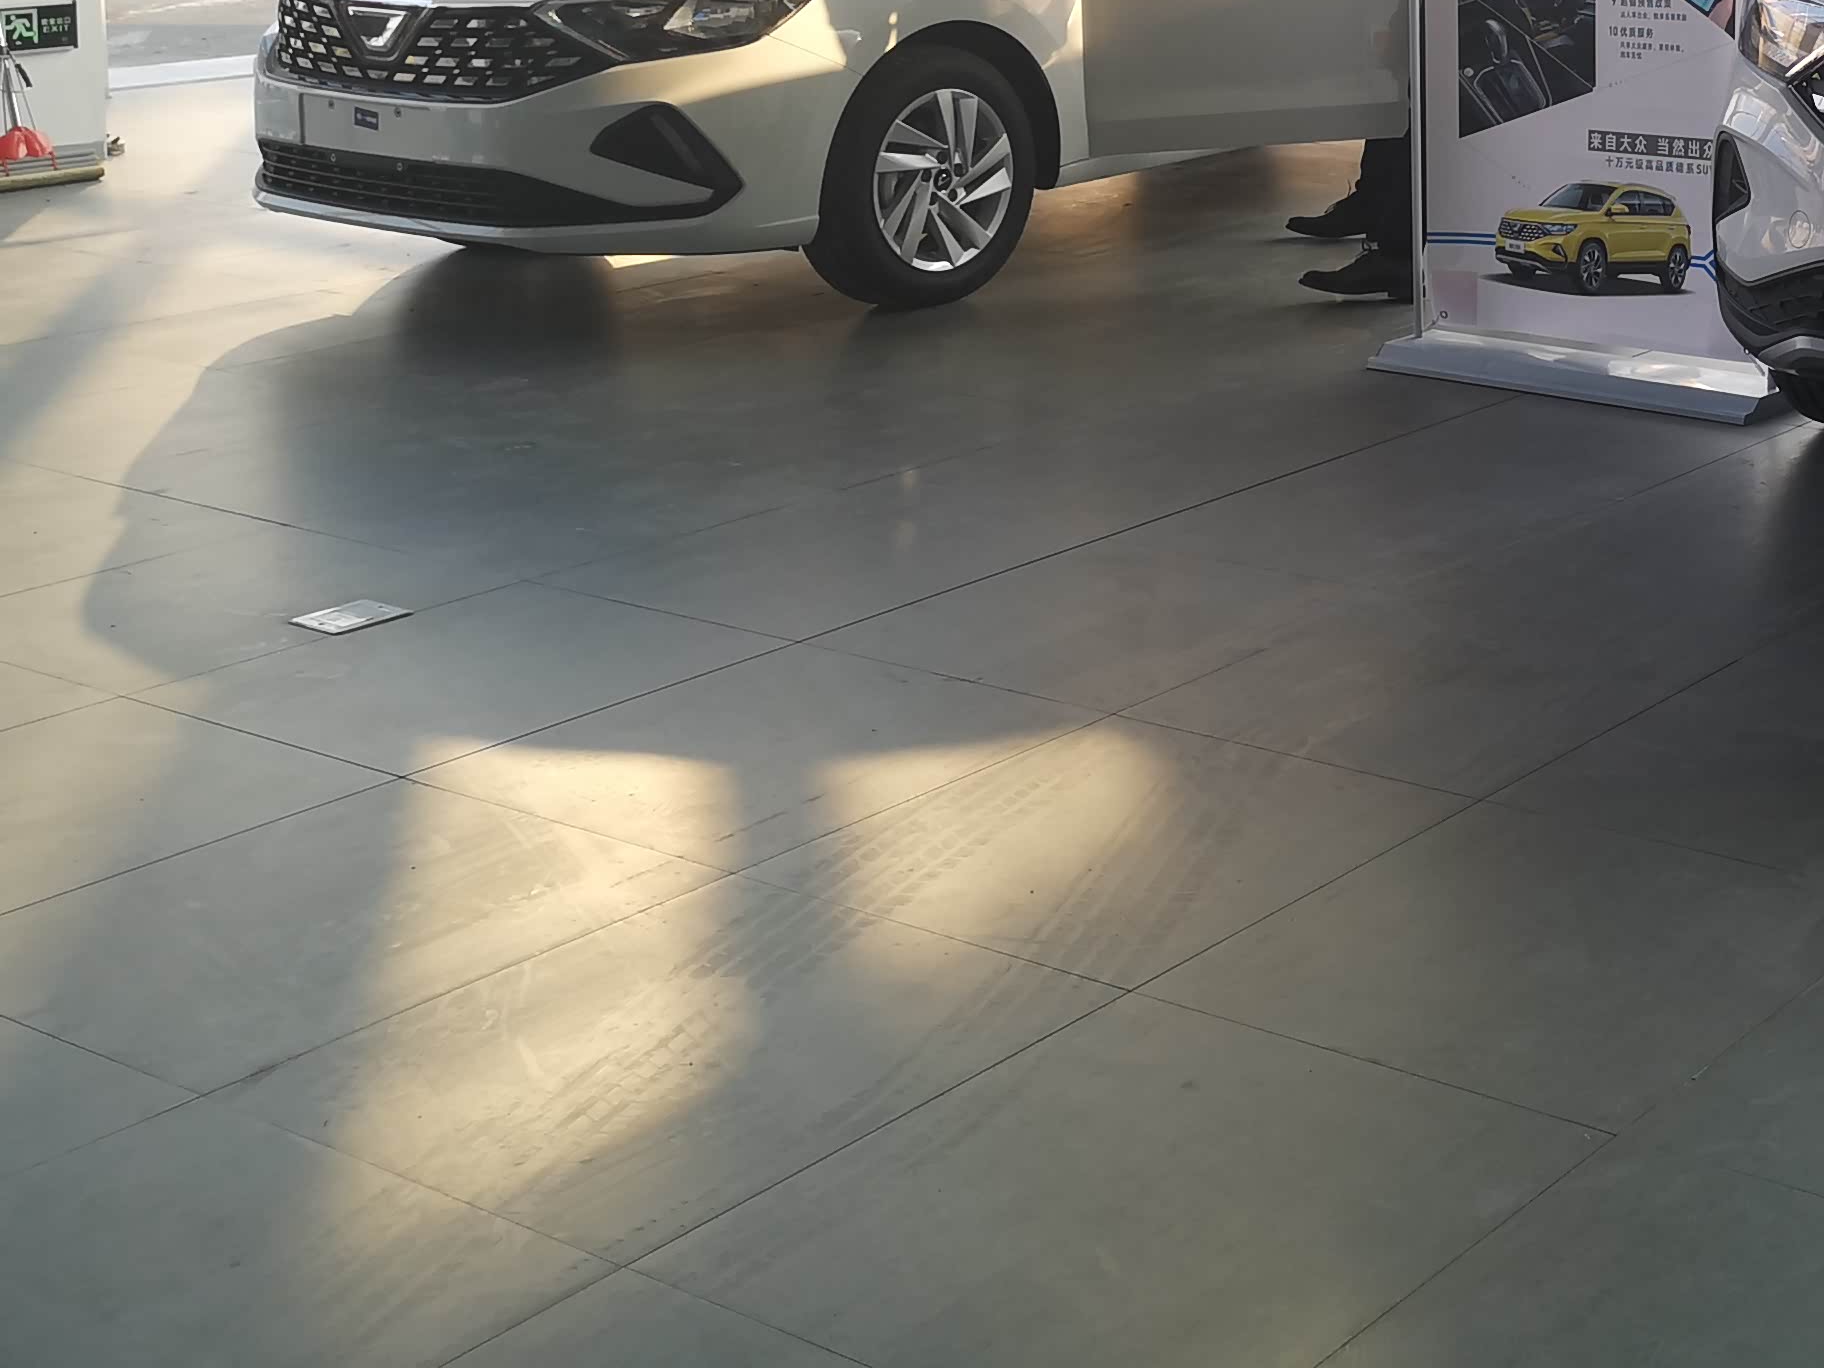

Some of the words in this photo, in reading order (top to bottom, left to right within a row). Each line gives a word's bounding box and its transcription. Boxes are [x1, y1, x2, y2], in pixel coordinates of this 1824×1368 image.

[43, 25, 69, 33] EXIT
[1590, 132, 1648, 153] 来自大众
[1605, 155, 1712, 175] 十万元级高品质德系SU
